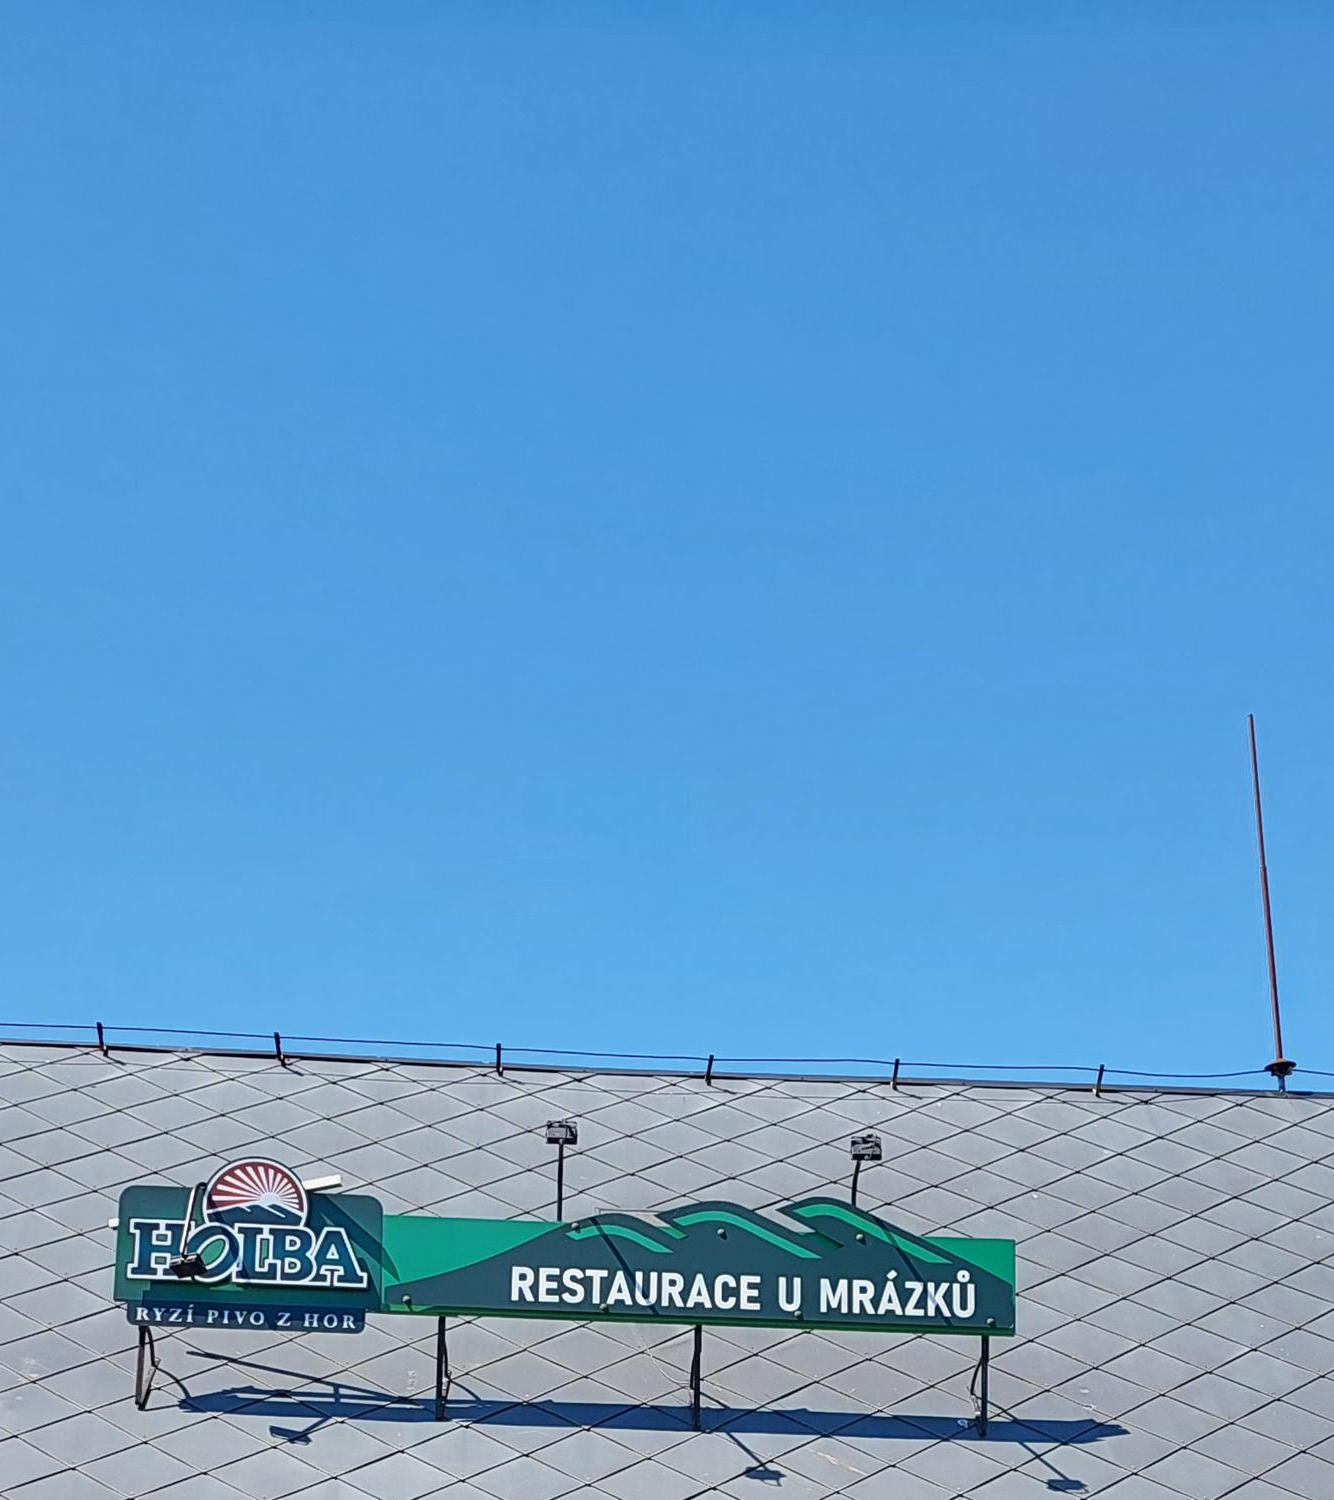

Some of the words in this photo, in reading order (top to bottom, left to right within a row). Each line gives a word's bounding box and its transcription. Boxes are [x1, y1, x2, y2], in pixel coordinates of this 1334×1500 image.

[126, 1218, 368, 1288] HOLBA
[135, 1303, 194, 1323] RYZÍ
[206, 1309, 265, 1326] PIVO
[277, 1312, 292, 1328] Z
[304, 1313, 356, 1330] HOR
[511, 1266, 761, 1310] RESTAURACE
[778, 1276, 800, 1312] U
[819, 1270, 976, 1318] MRÁZKŮ
